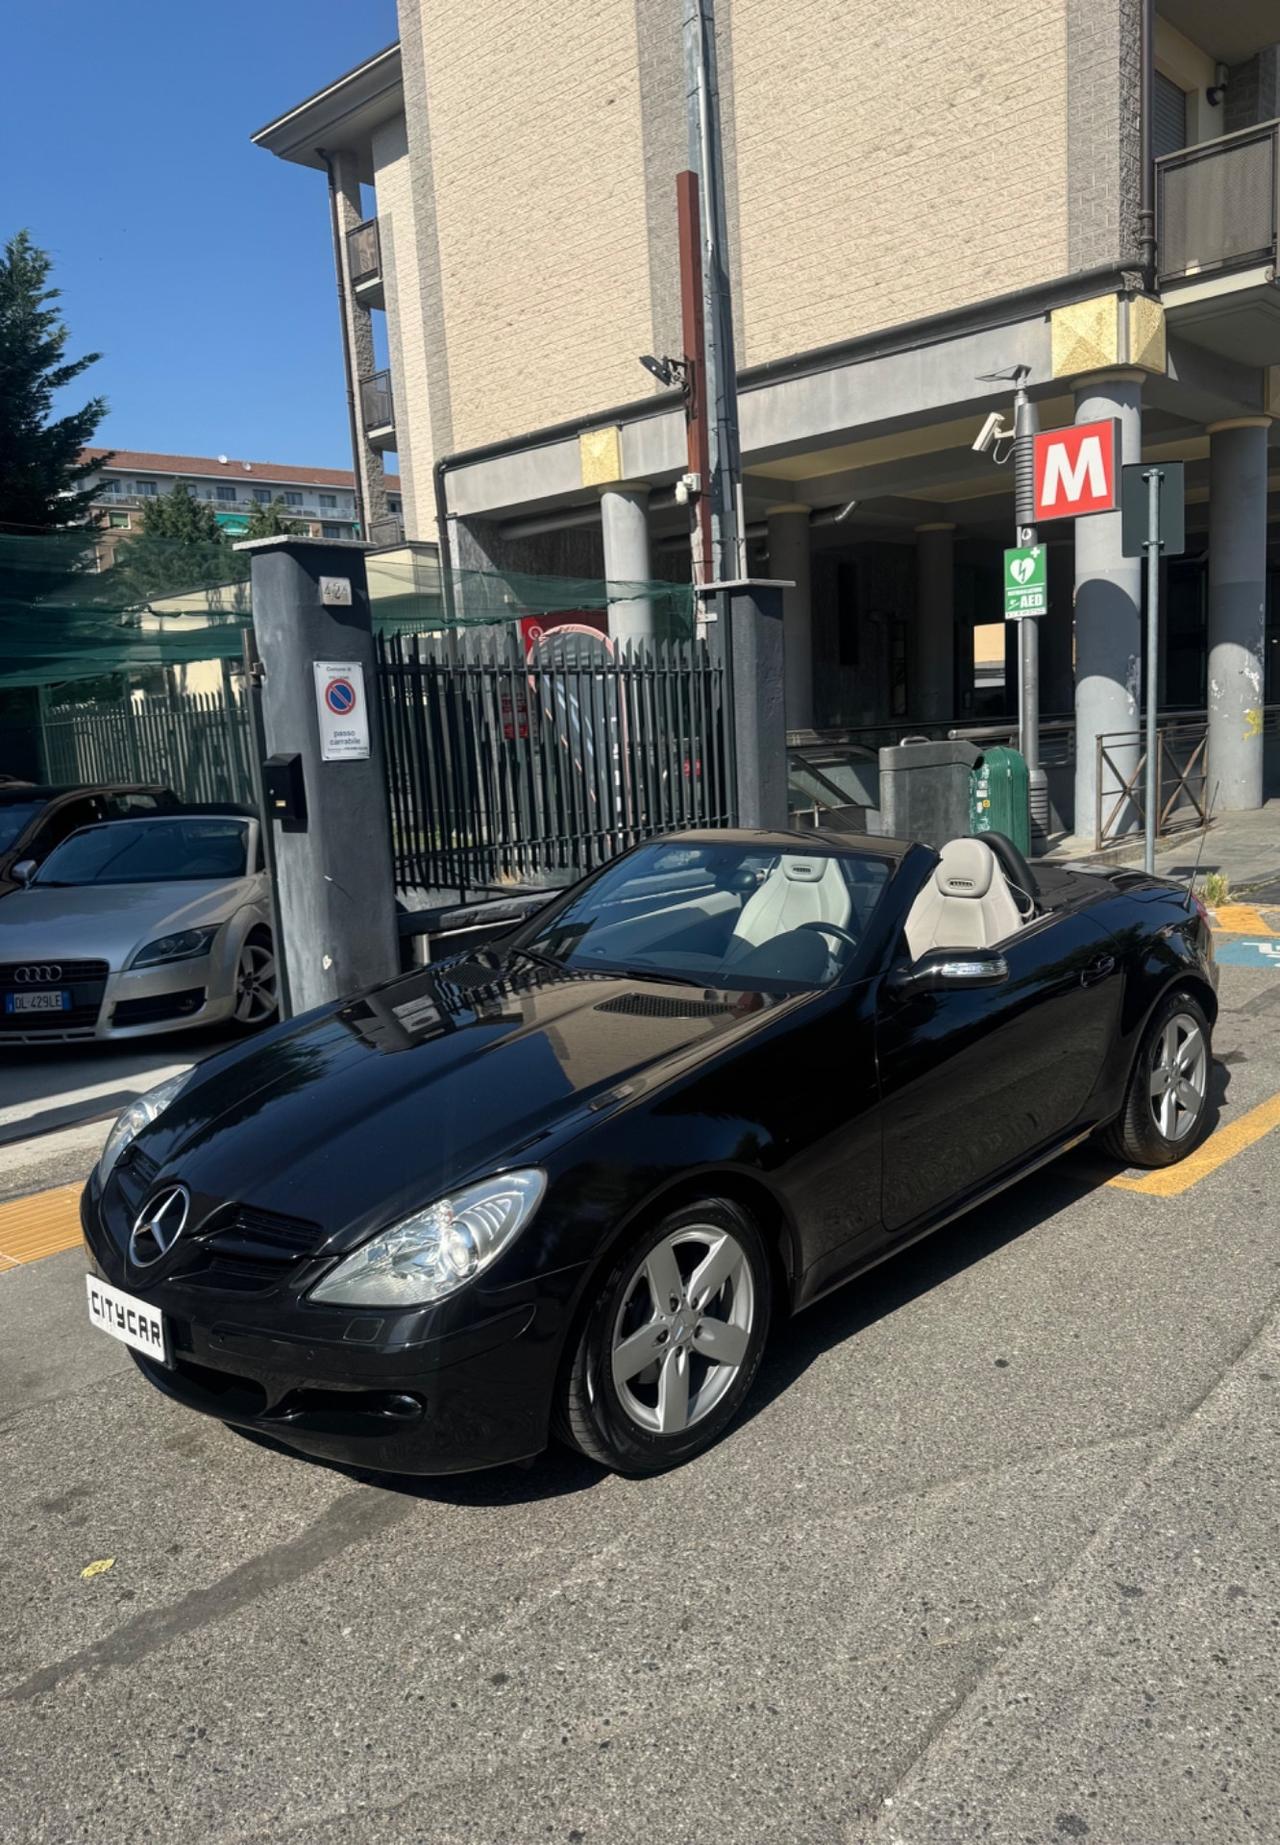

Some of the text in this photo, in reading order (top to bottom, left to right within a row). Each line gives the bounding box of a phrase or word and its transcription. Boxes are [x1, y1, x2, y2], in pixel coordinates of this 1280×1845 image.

[1041, 436, 1107, 506] M
[1020, 594, 1044, 608] AED
[91, 1290, 162, 1348] CITYCAR
